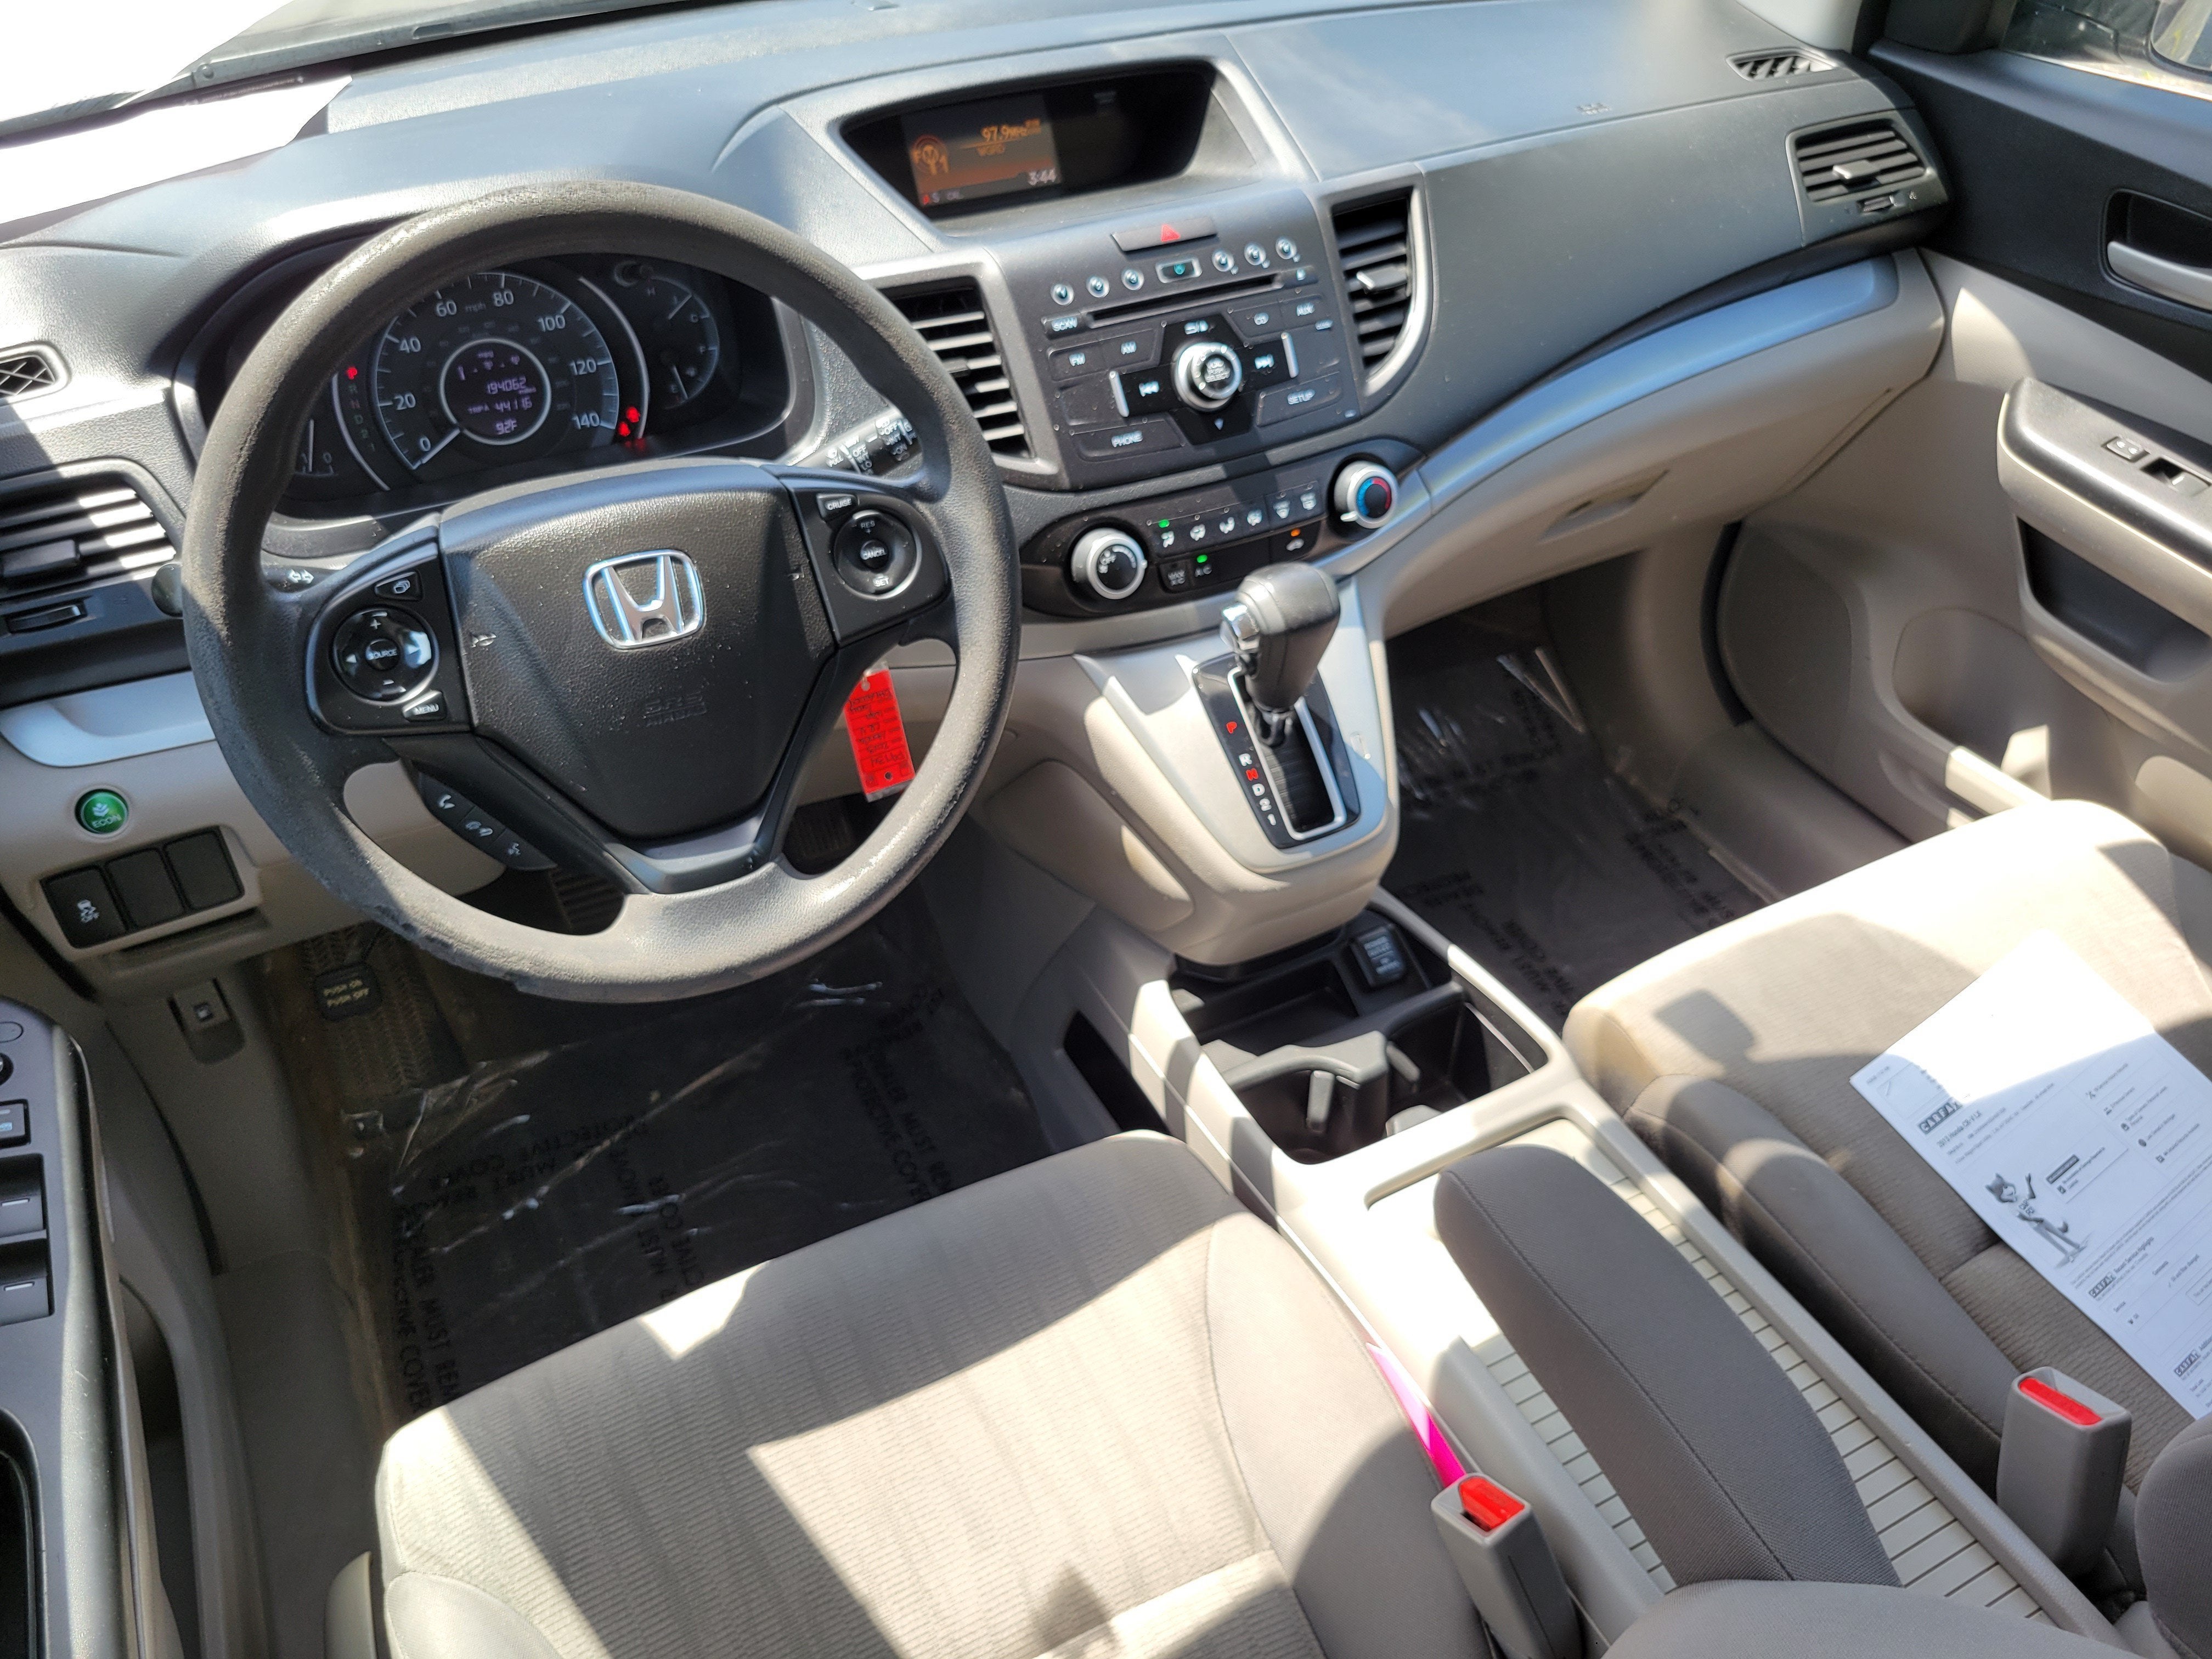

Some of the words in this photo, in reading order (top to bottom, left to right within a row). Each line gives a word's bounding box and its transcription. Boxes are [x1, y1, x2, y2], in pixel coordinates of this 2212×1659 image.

[493, 289, 514, 307] 80
[436, 300, 457, 317] 60
[1296, 302, 1315, 316] AUX
[537, 314, 566, 332] 100
[1051, 316, 1077, 331] SCAN
[398, 335, 422, 354] 40
[1121, 341, 1137, 355] AM
[569, 357, 597, 376] 120
[1069, 352, 1085, 366] FM
[487, 375, 527, 394] 194062
[394, 392, 416, 410] 20
[1287, 388, 1316, 405] SETUP
[572, 413, 600, 430] 140
[419, 436, 431, 452] 0
[1111, 430, 1143, 448] PHONE
[853, 444, 866, 459] OFF
[826, 496, 852, 511] CRUISE
[861, 520, 876, 528] RES
[860, 546, 887, 560] CANCEL
[873, 575, 889, 587] SET
[366, 647, 398, 661] SOURCE
[413, 703, 439, 715] MENU
[1226, 721, 1238, 734] P
[1239, 753, 1252, 767] R
[1246, 769, 1259, 781] N
[1252, 783, 1266, 797] D
[1259, 799, 1272, 811] 2
[92, 814, 122, 828] ECON
[1267, 814, 1277, 826] 1
[323, 984, 347, 996] PUSH
[348, 979, 363, 989] ON
[327, 995, 352, 1007] PUSH
[352, 988, 369, 1000] OFF
[1936, 1135, 1951, 1148] 2013
[1948, 1124, 1964, 1139] Honda
[1961, 1115, 1975, 1128] CR-V
